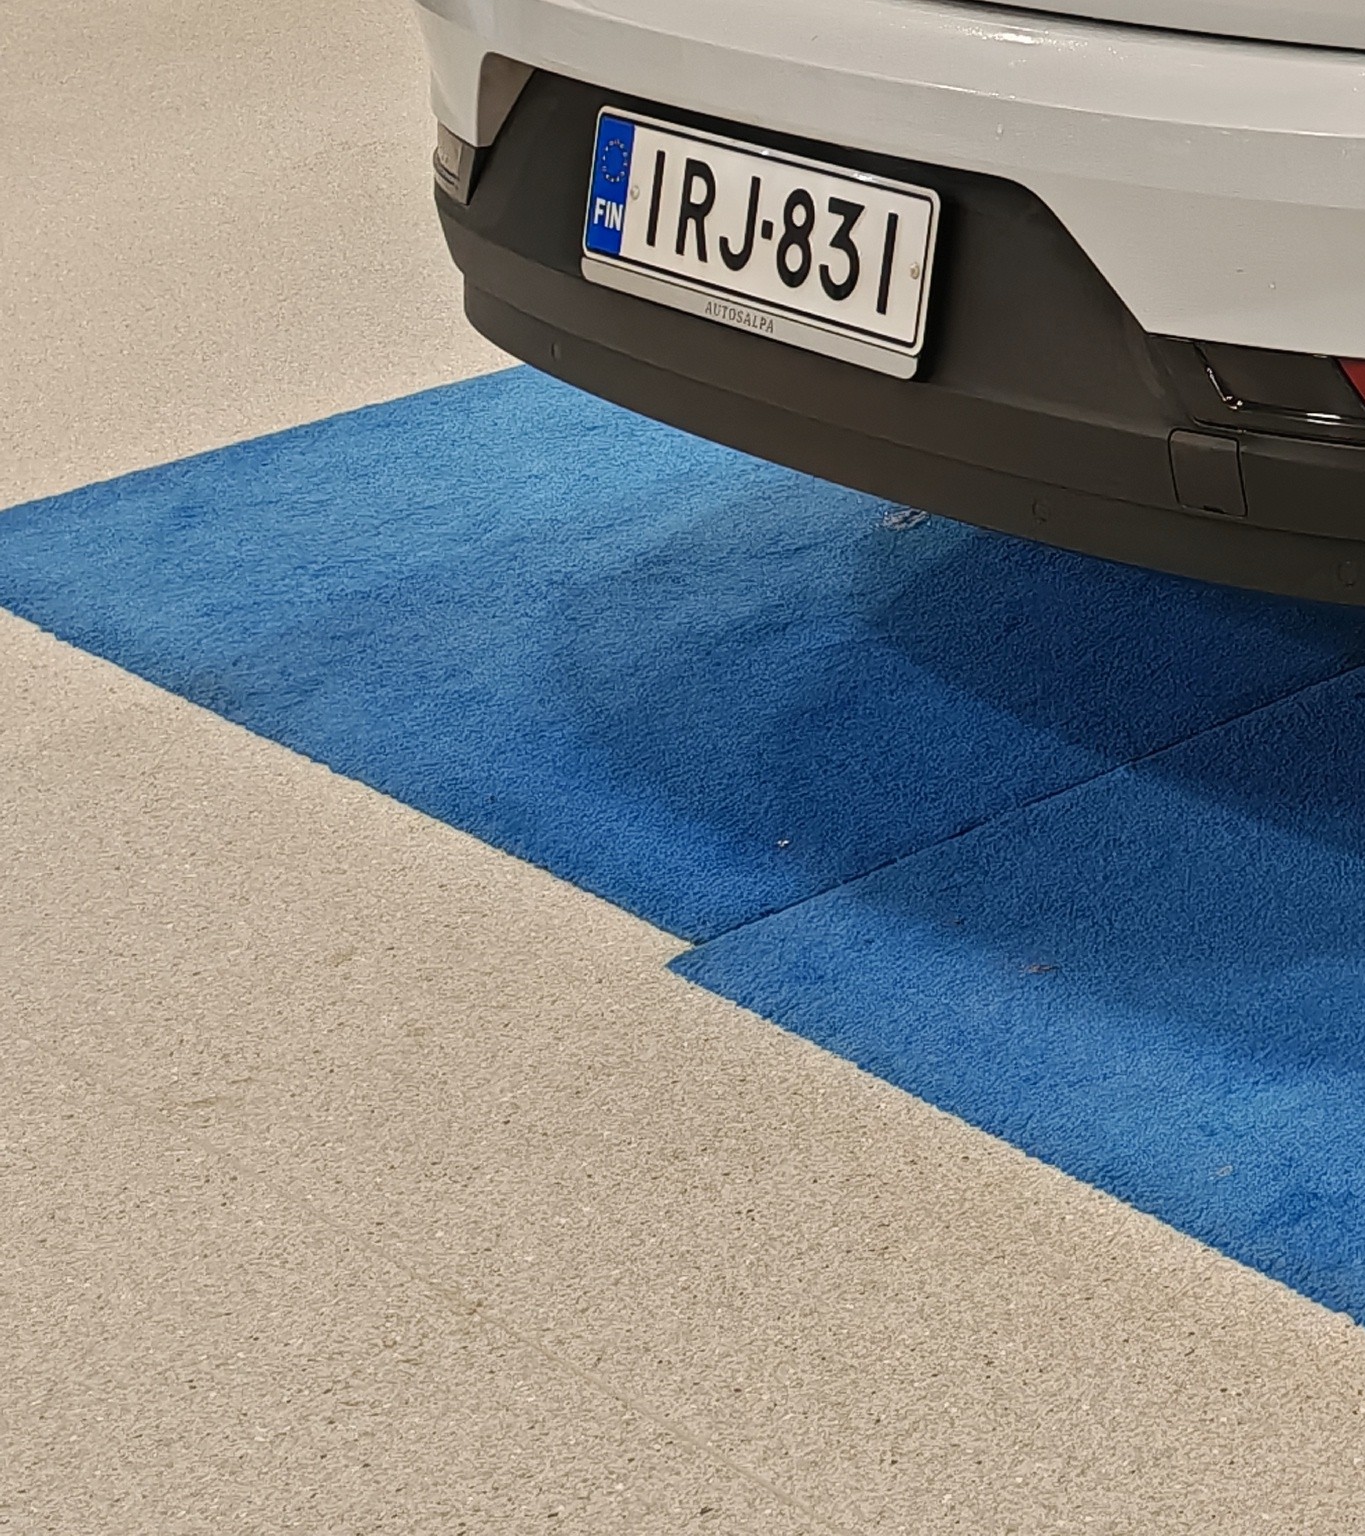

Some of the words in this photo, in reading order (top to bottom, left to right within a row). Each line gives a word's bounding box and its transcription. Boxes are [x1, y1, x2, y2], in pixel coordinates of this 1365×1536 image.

[593, 196, 625, 232] FIN
[645, 149, 899, 316] IRJ-831
[704, 300, 775, 334] AUTOSALPA
